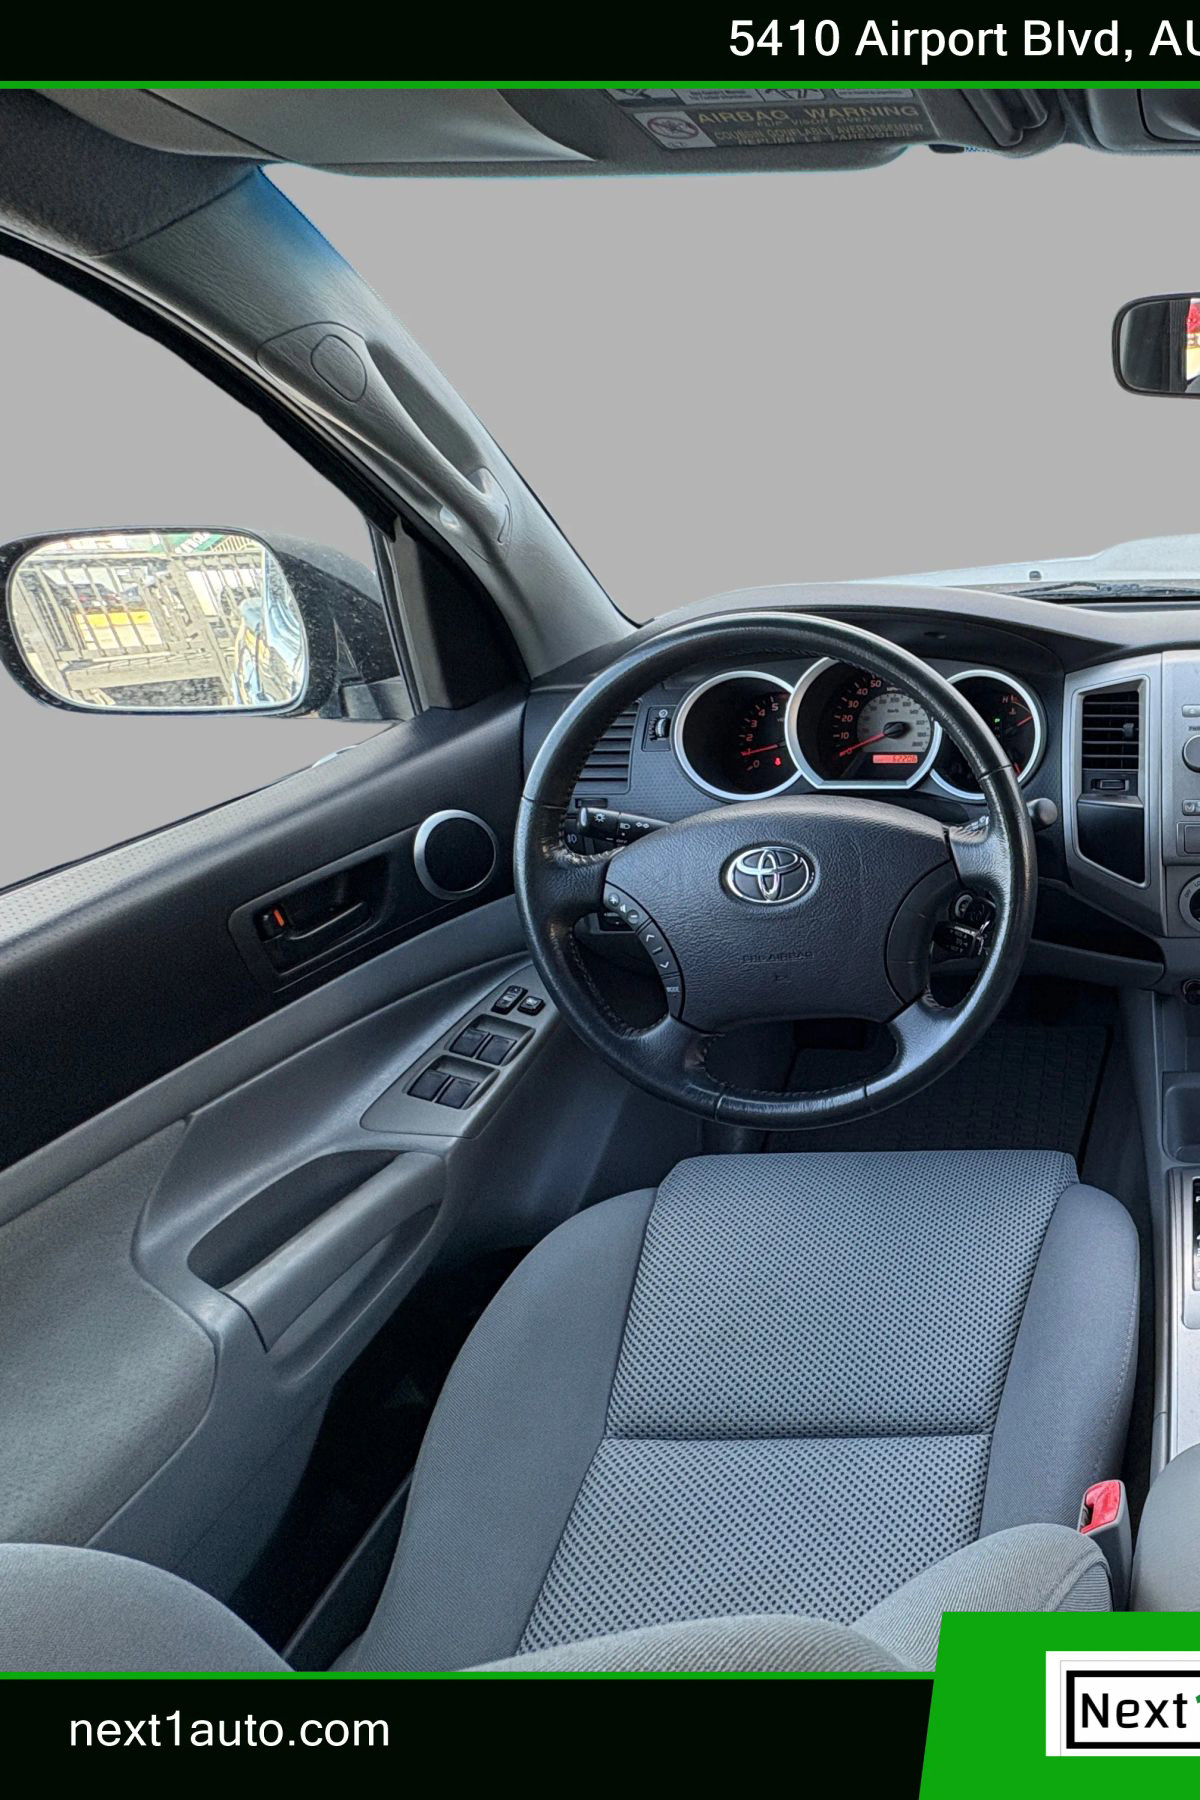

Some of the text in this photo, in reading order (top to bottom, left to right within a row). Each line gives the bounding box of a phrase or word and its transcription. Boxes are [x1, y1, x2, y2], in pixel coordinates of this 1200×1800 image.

[698, 105, 919, 124] AIRBAG WARNING
[870, 680, 882, 688] 50
[857, 688, 869, 696] 40
[771, 703, 779, 711] 5
[758, 709, 766, 717] 4
[751, 720, 758, 728] 3
